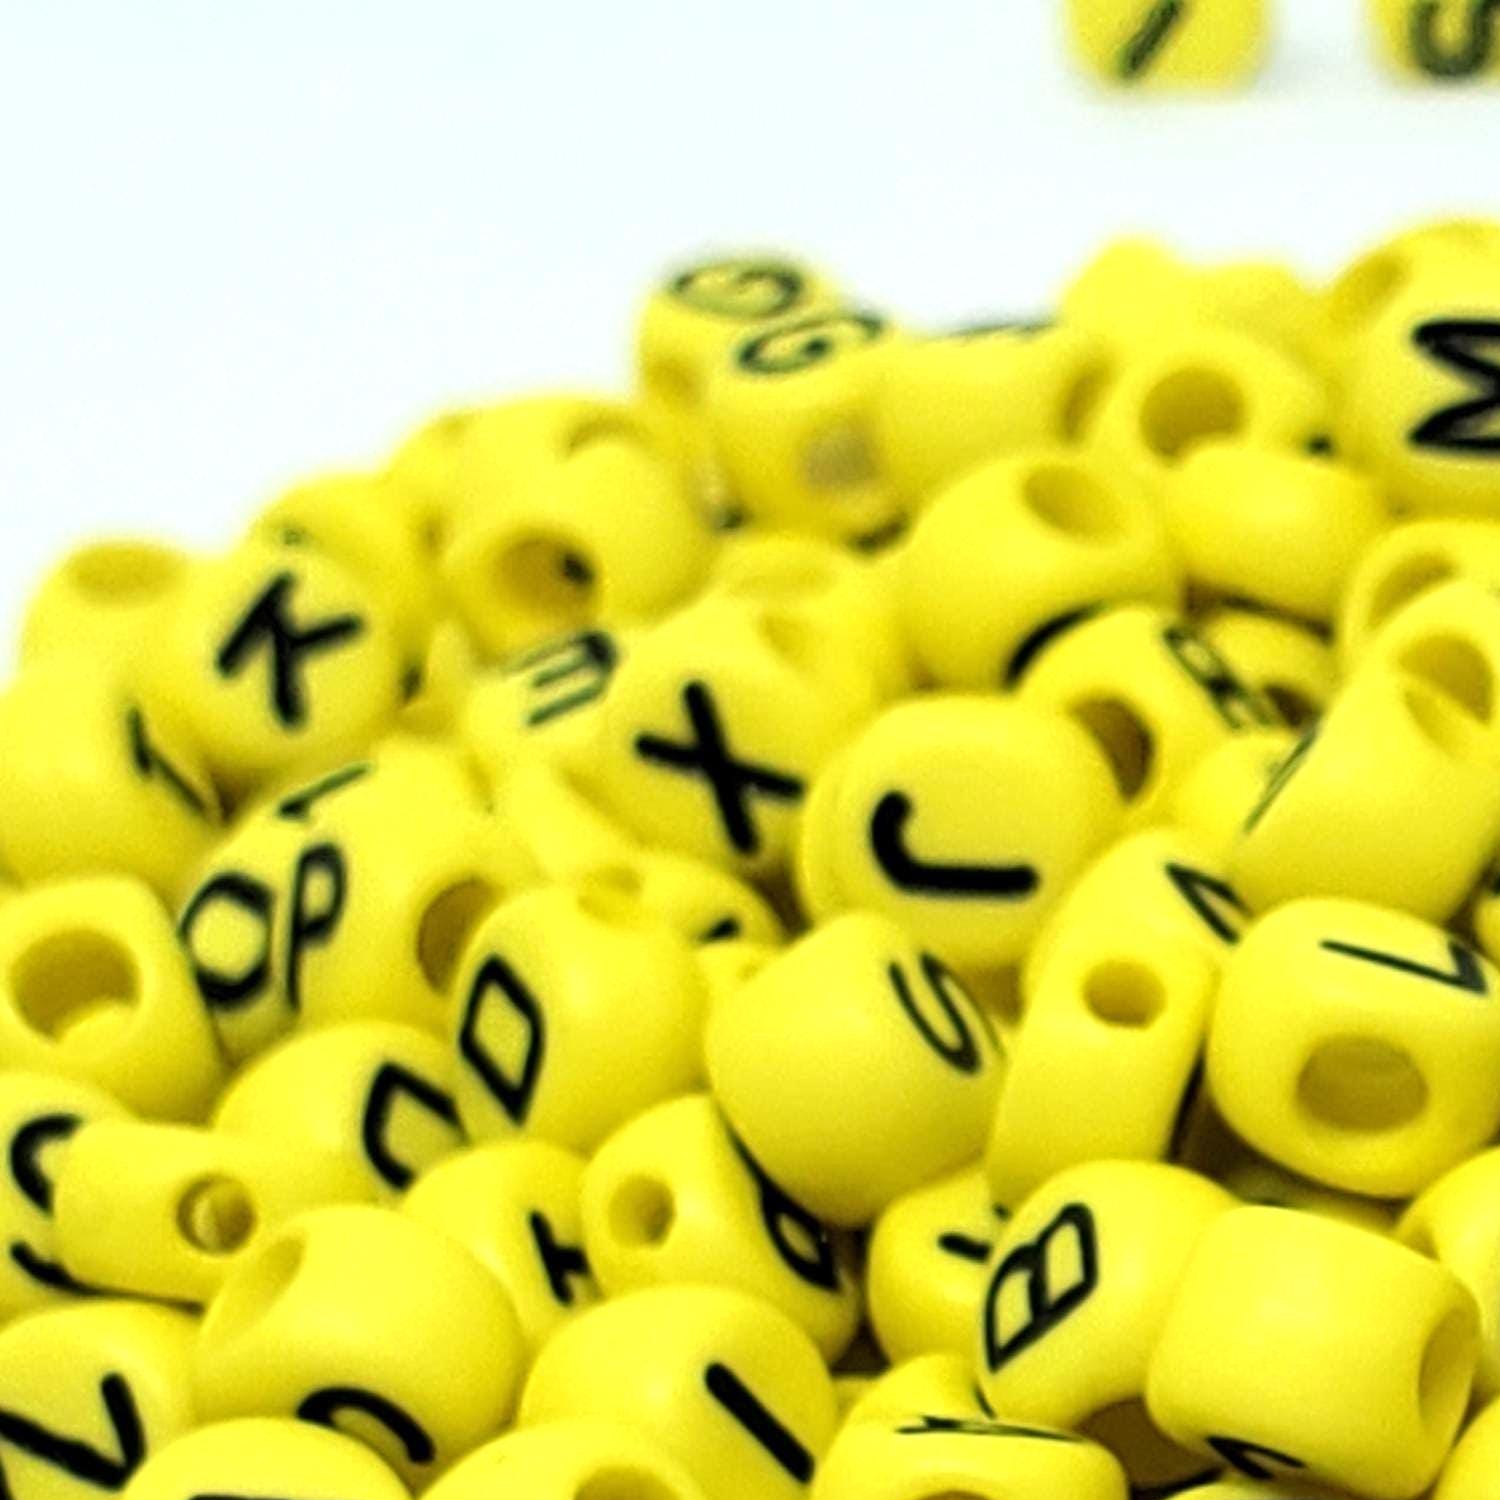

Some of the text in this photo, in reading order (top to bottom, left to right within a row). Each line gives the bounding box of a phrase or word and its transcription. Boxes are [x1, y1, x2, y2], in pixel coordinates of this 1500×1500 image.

[216, 574, 365, 728] K
[635, 680, 804, 861] X
[867, 789, 1040, 902] J
[283, 842, 348, 1017] P
[457, 953, 547, 1128] D
[984, 1202, 1099, 1374] B
